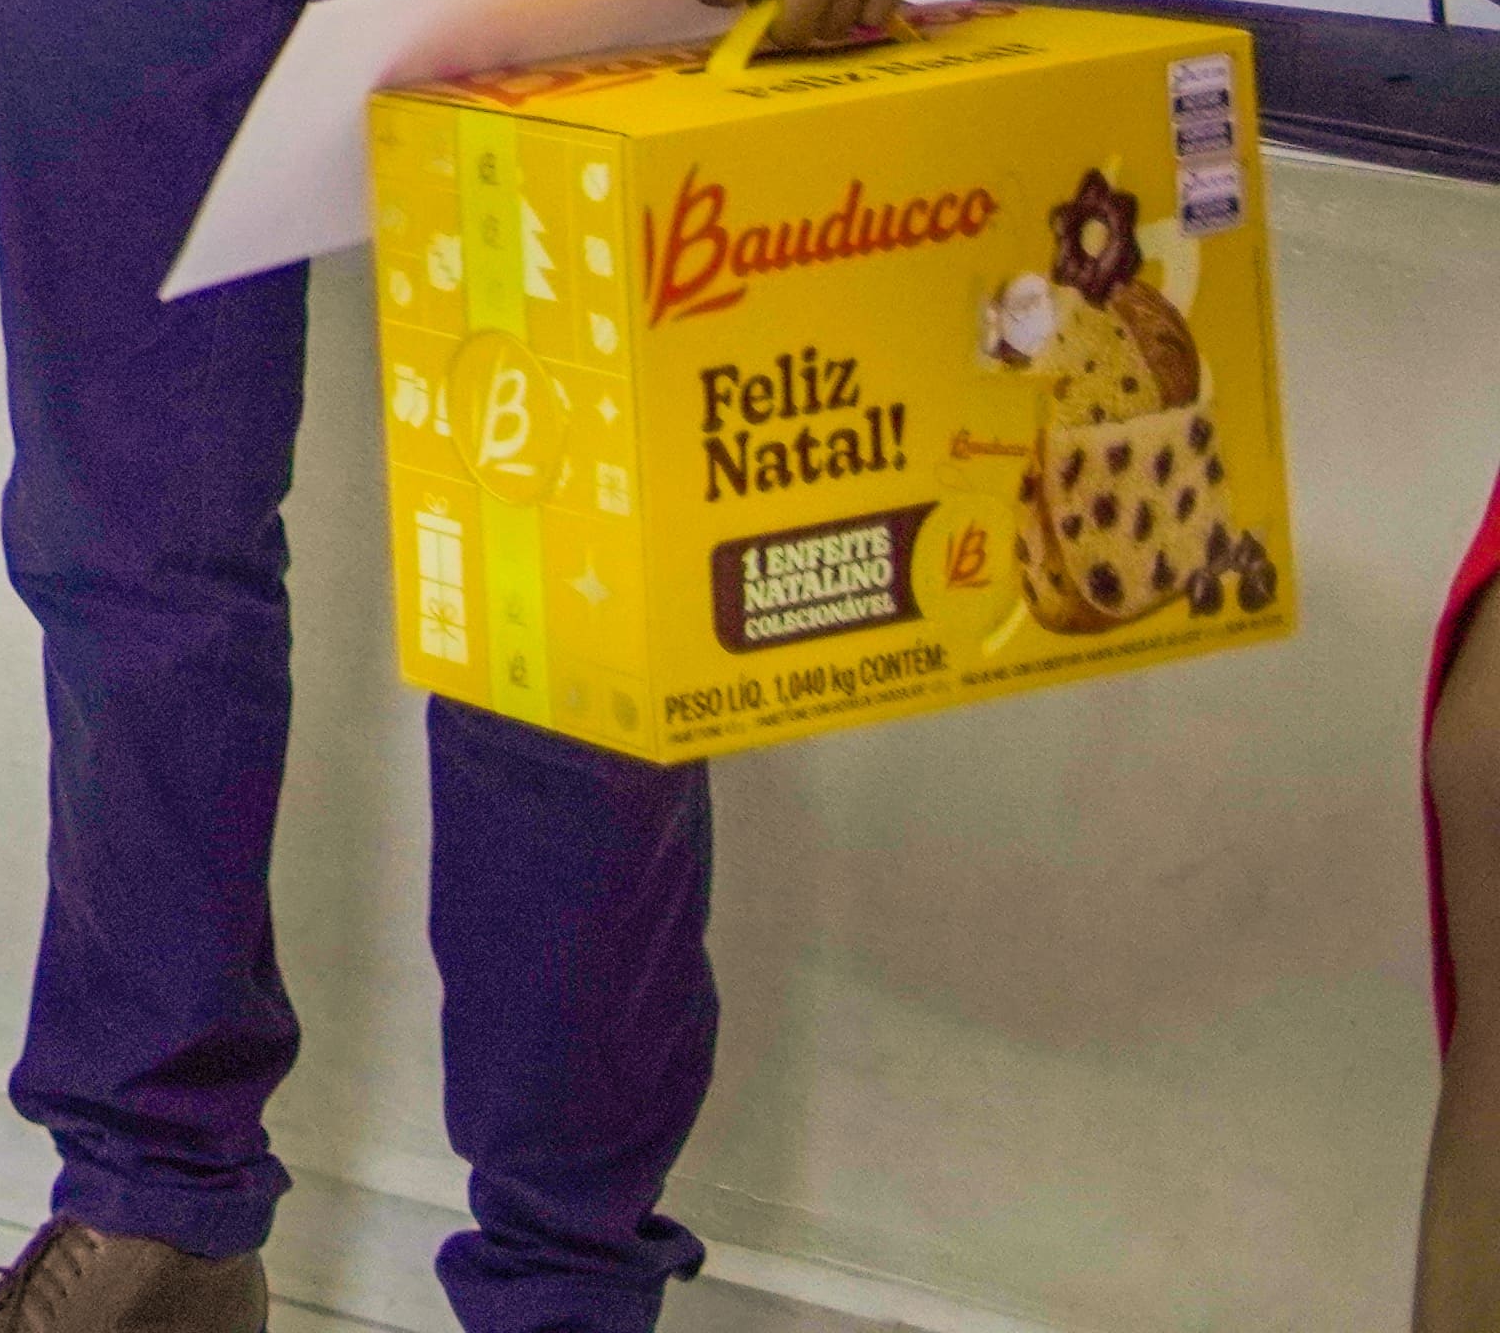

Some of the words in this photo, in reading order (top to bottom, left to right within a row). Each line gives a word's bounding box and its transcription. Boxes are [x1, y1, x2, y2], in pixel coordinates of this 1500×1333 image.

[642, 161, 999, 331] Bauducco
[698, 345, 861, 434] Feliz
[702, 400, 907, 503] Natal!
[741, 546, 761, 582] 1
[764, 524, 893, 579] ENFEITE
[743, 556, 895, 613] NATALINO
[664, 687, 723, 725] PESO
[830, 660, 857, 697] kg
